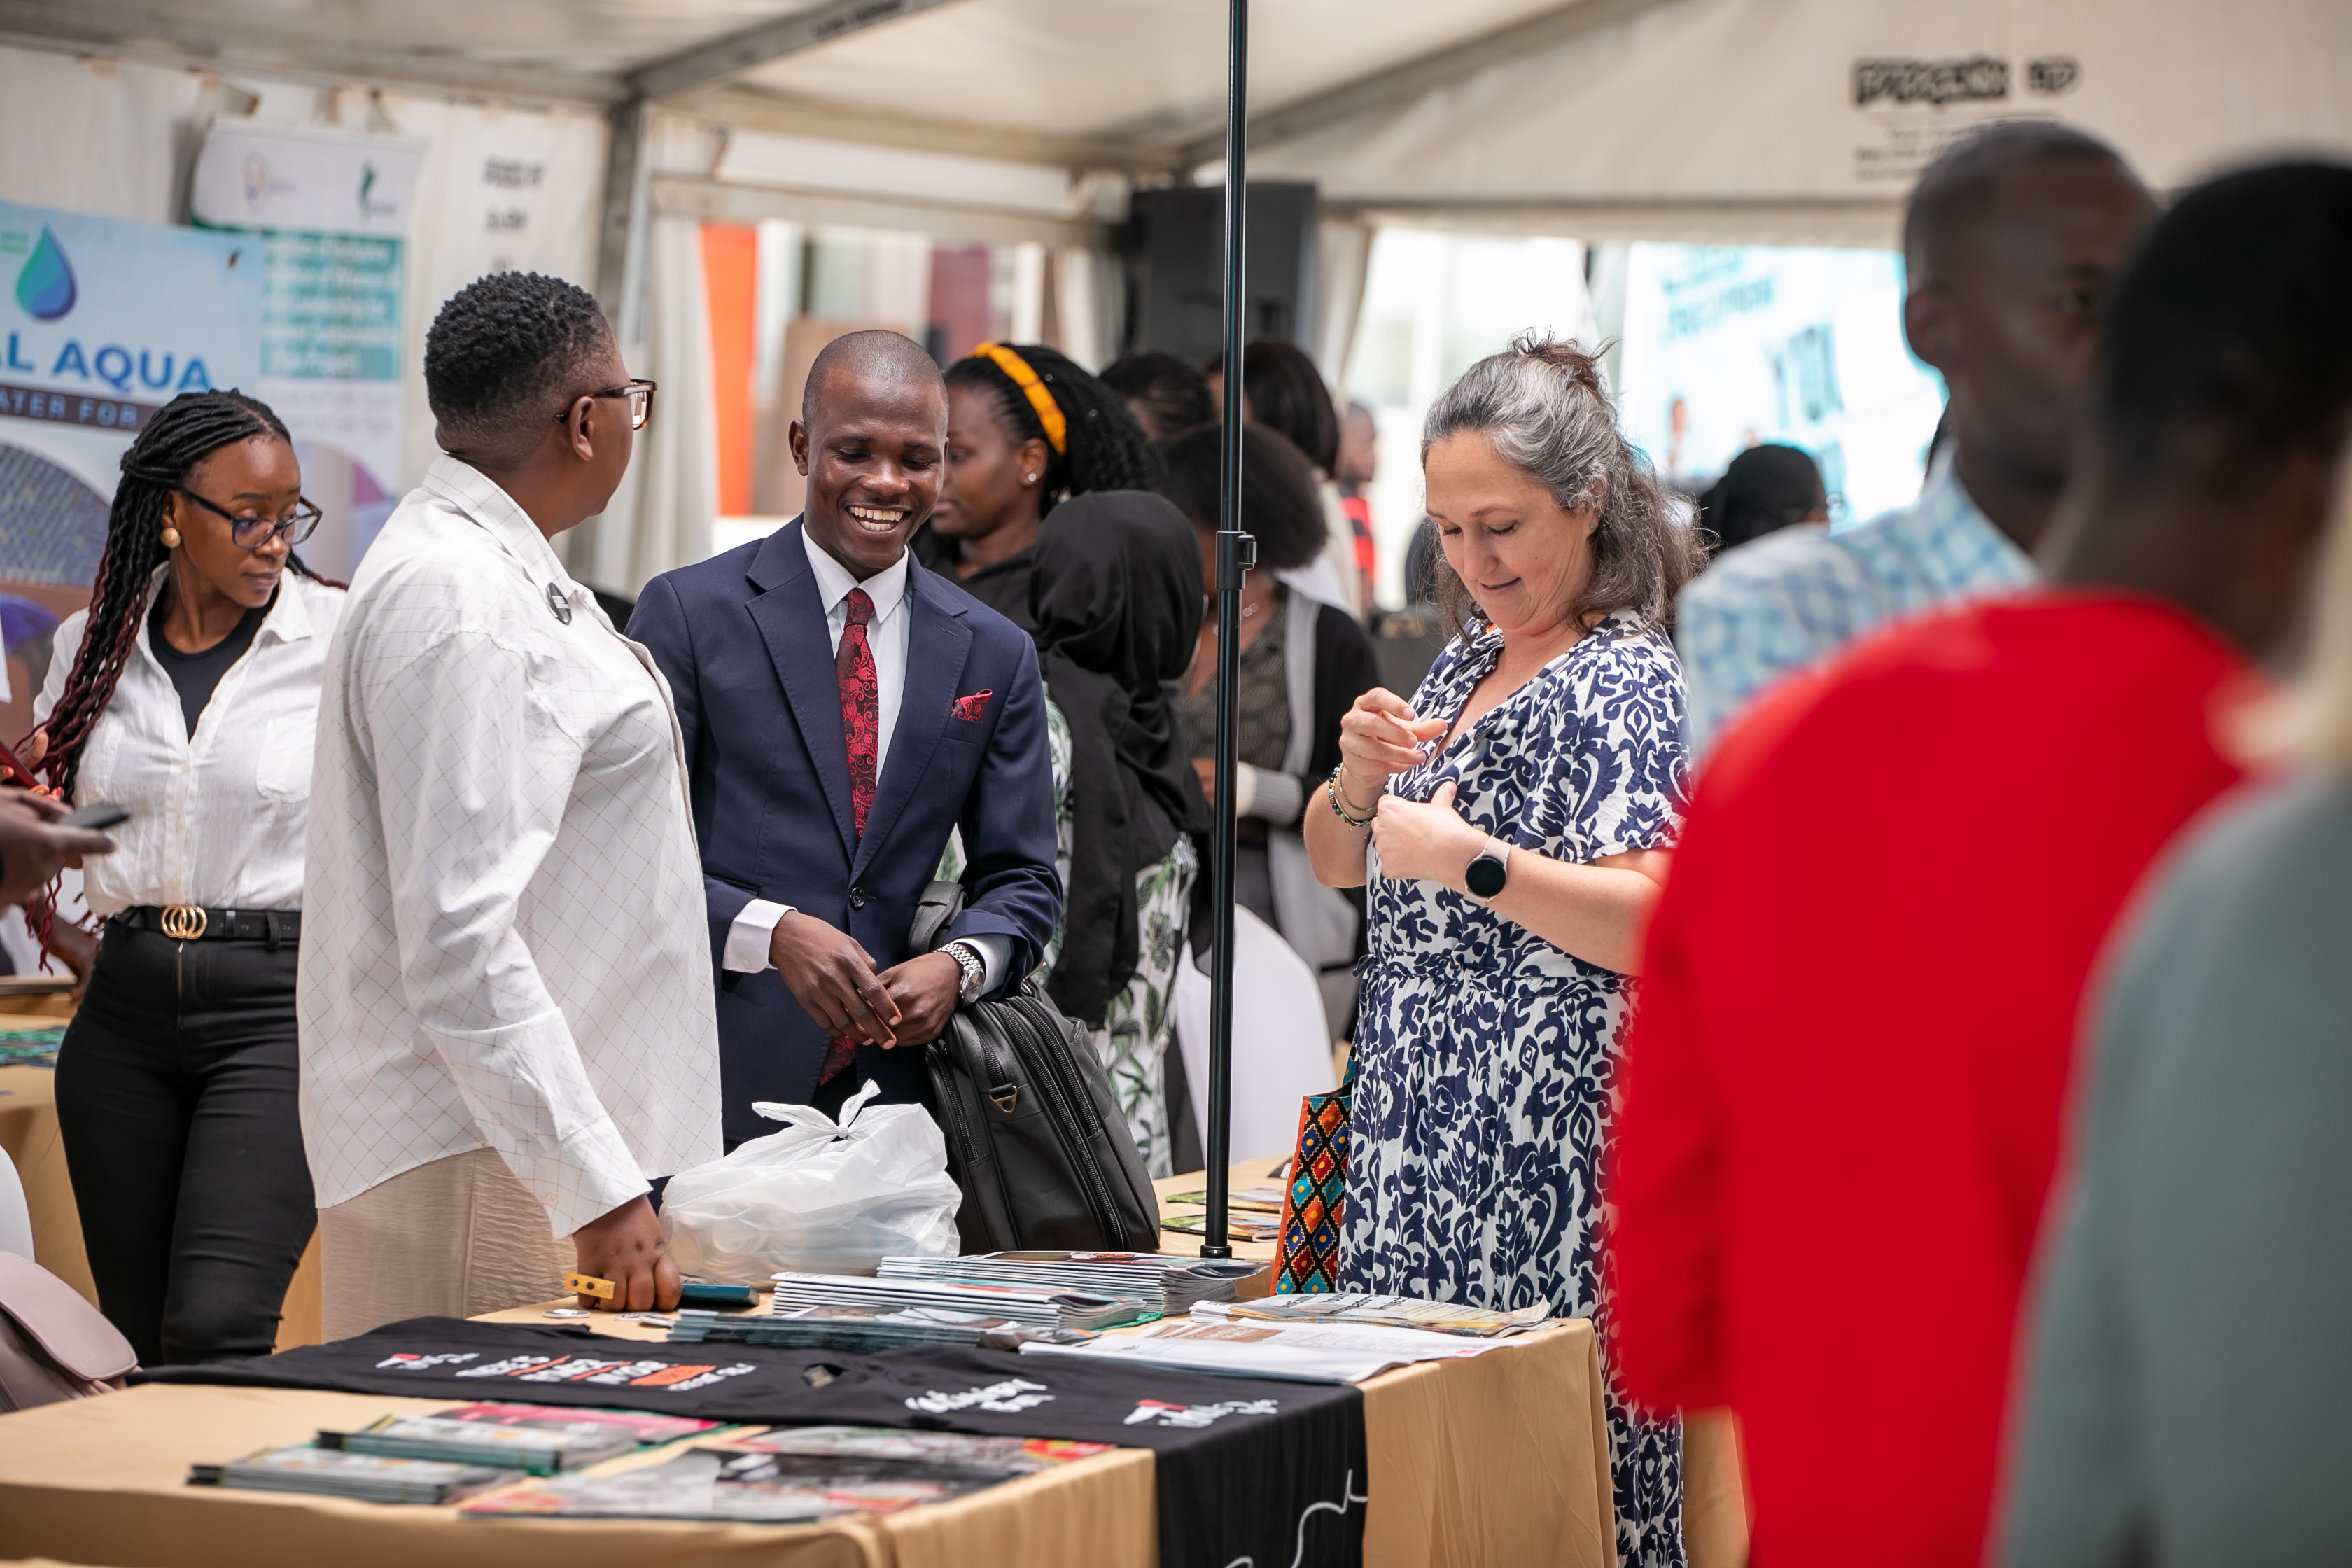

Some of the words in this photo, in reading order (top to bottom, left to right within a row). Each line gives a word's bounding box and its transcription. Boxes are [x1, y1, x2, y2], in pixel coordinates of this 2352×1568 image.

[0, 330, 34, 372] L
[51, 338, 212, 394] AQUA
[78, 397, 139, 429] FOR
